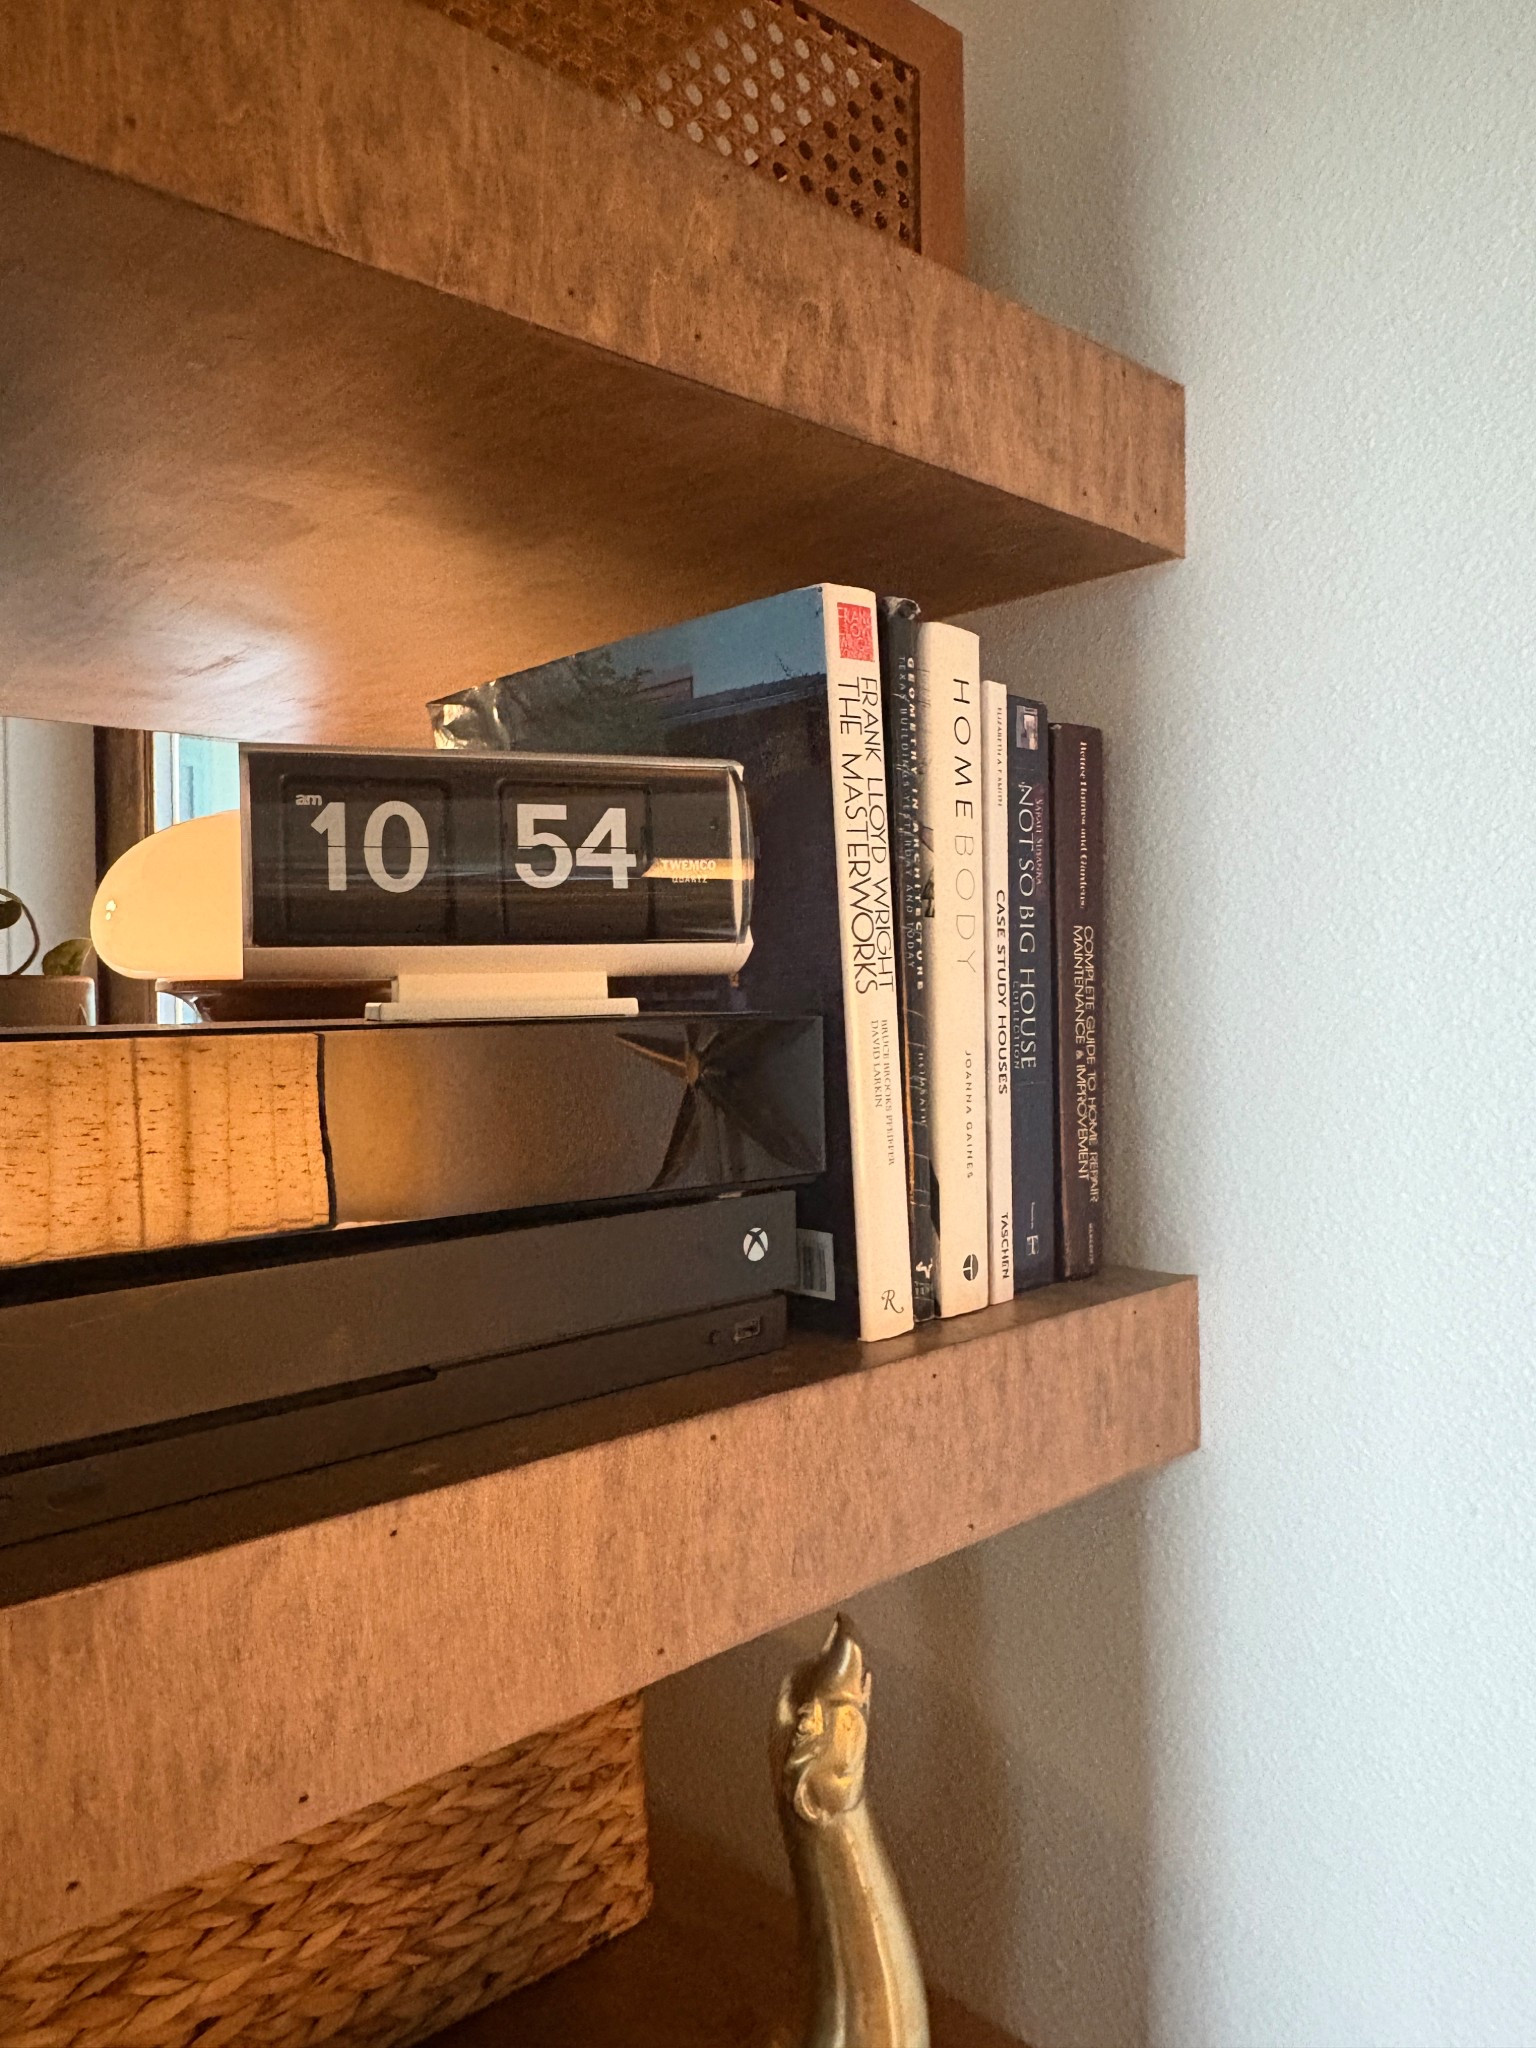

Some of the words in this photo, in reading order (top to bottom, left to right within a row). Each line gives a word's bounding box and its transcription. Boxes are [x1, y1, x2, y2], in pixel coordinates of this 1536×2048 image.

[838, 676, 862, 735] THE
[898, 656, 908, 699] TEXAS
[861, 677, 882, 762] FRANK
[907, 657, 918, 775] GEOMETRY
[900, 708, 909, 786] BUILDINGS
[295, 793, 323, 806] am
[868, 778, 887, 864] LLOYD
[912, 788, 920, 809] IN
[1018, 784, 1034, 851] NOT
[310, 800, 430, 893] 10
[513, 803, 637, 889] 54
[661, 859, 717, 872] TWEMCO
[842, 753, 878, 994] MASTERWORKS
[906, 884, 914, 913] AND
[912, 822, 924, 990] ARCHITECTURE
[1018, 858, 1034, 897] SO
[873, 877, 894, 992] WRIGHT
[996, 889, 1006, 938] CASE
[1019, 905, 1036, 953] BIG
[907, 922, 915, 968] TODAY
[1083, 925, 1096, 1010] COMPLETE
[997, 945, 1007, 1007] STUDY
[1073, 925, 1085, 1044] MAINTENANCE
[871, 1020, 881, 1060] DAVID
[881, 1019, 891, 1059] BRUCE
[1020, 968, 1037, 1069] HOUSE
[1085, 1015, 1096, 1064] GUIDE
[964, 1050, 973, 1115] JOANNA
[998, 1015, 1008, 1095] HOUSES
[1075, 1049, 1084, 1060] &
[1086, 1069, 1097, 1091] TO
[872, 1063, 883, 1108] LARKIN
[883, 1063, 893, 1112] BROOKS
[965, 1121, 974, 1179] GAINES
[1076, 1064, 1089, 1181] IMPROVEMENT
[1088, 1097, 1098, 1146] HOME
[1089, 1151, 1100, 1203] REPAIR
[1001, 1211, 1010, 1280] TASCHEN
